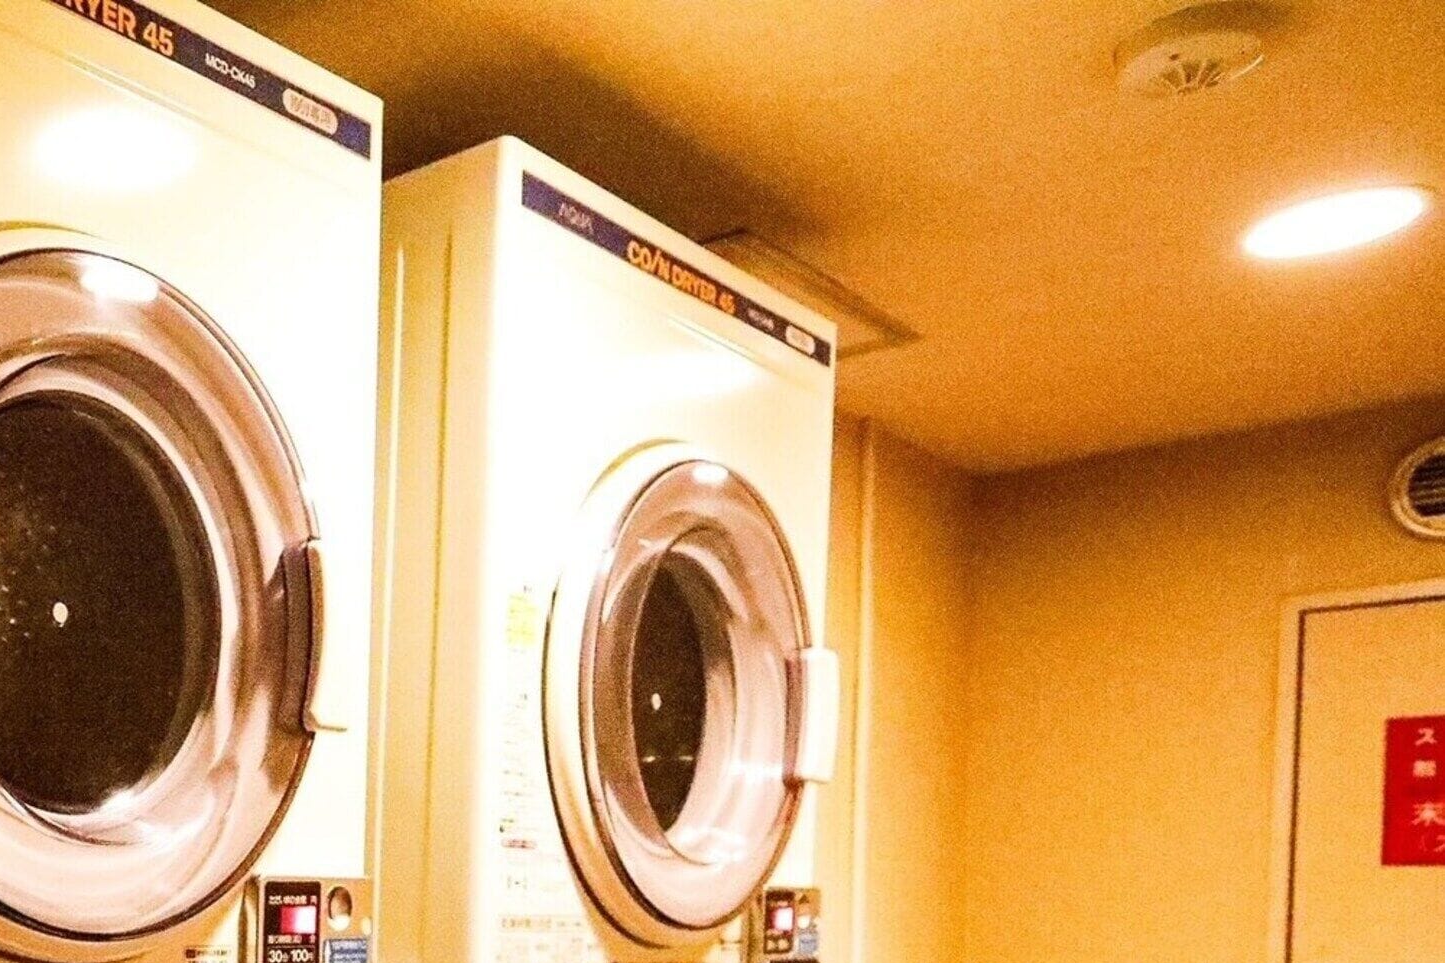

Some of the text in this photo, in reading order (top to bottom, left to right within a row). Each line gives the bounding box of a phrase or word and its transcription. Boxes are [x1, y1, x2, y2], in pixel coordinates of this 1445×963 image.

[142, 21, 174, 57] 45
[204, 52, 255, 89] MCD-CK45
[672, 270, 718, 303] DRYER
